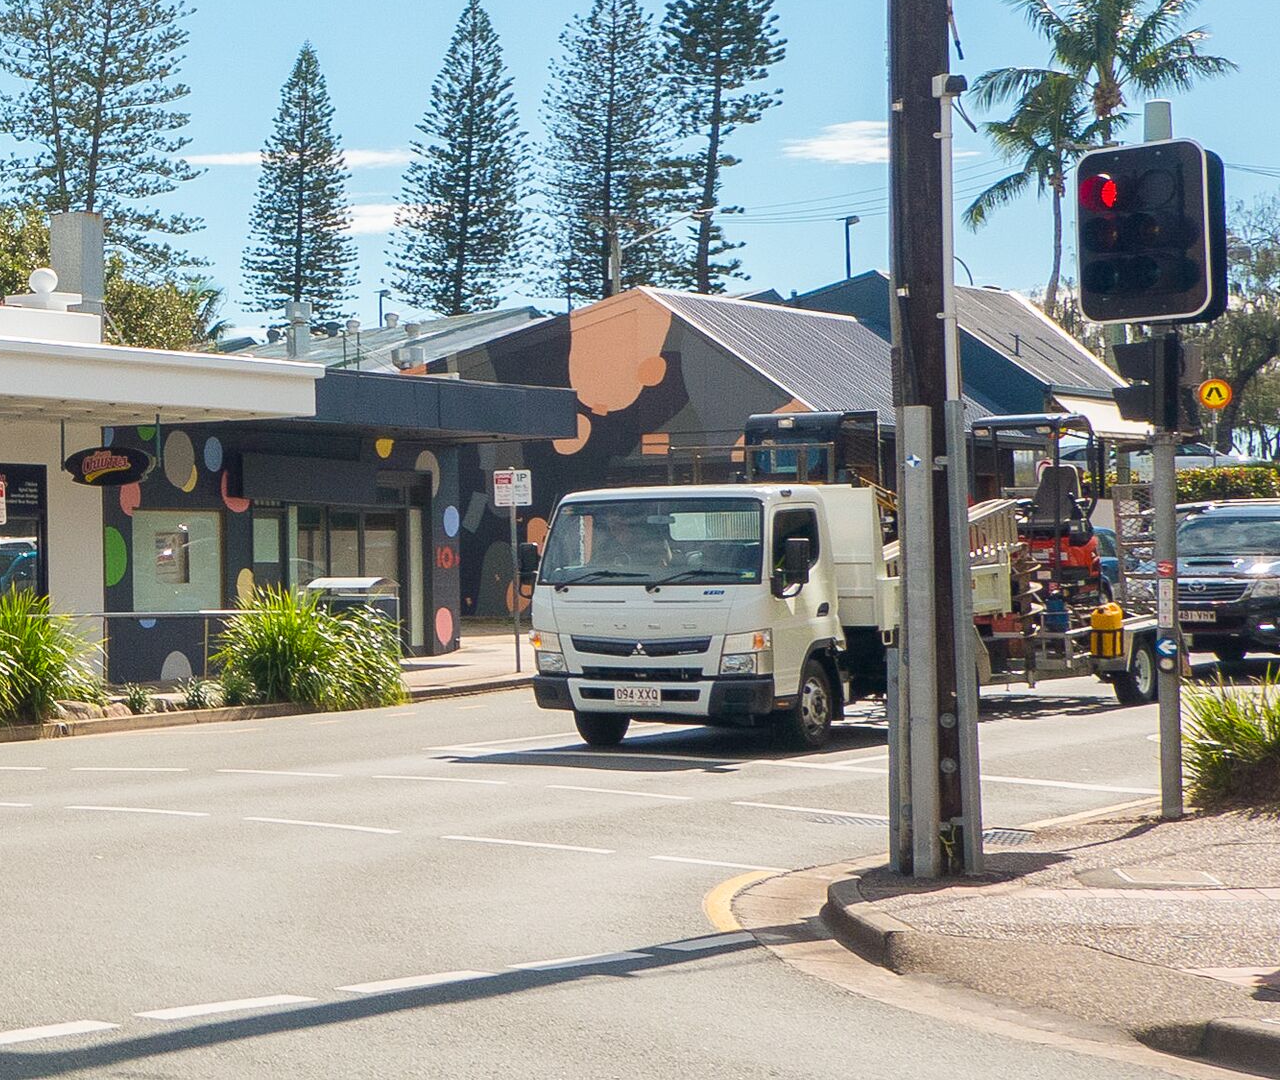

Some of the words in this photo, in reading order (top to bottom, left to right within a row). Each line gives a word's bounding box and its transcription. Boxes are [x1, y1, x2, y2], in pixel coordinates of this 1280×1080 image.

[516, 473, 527, 482] 1P
[616, 689, 634, 699] 094
[637, 689, 658, 700] XXQ
